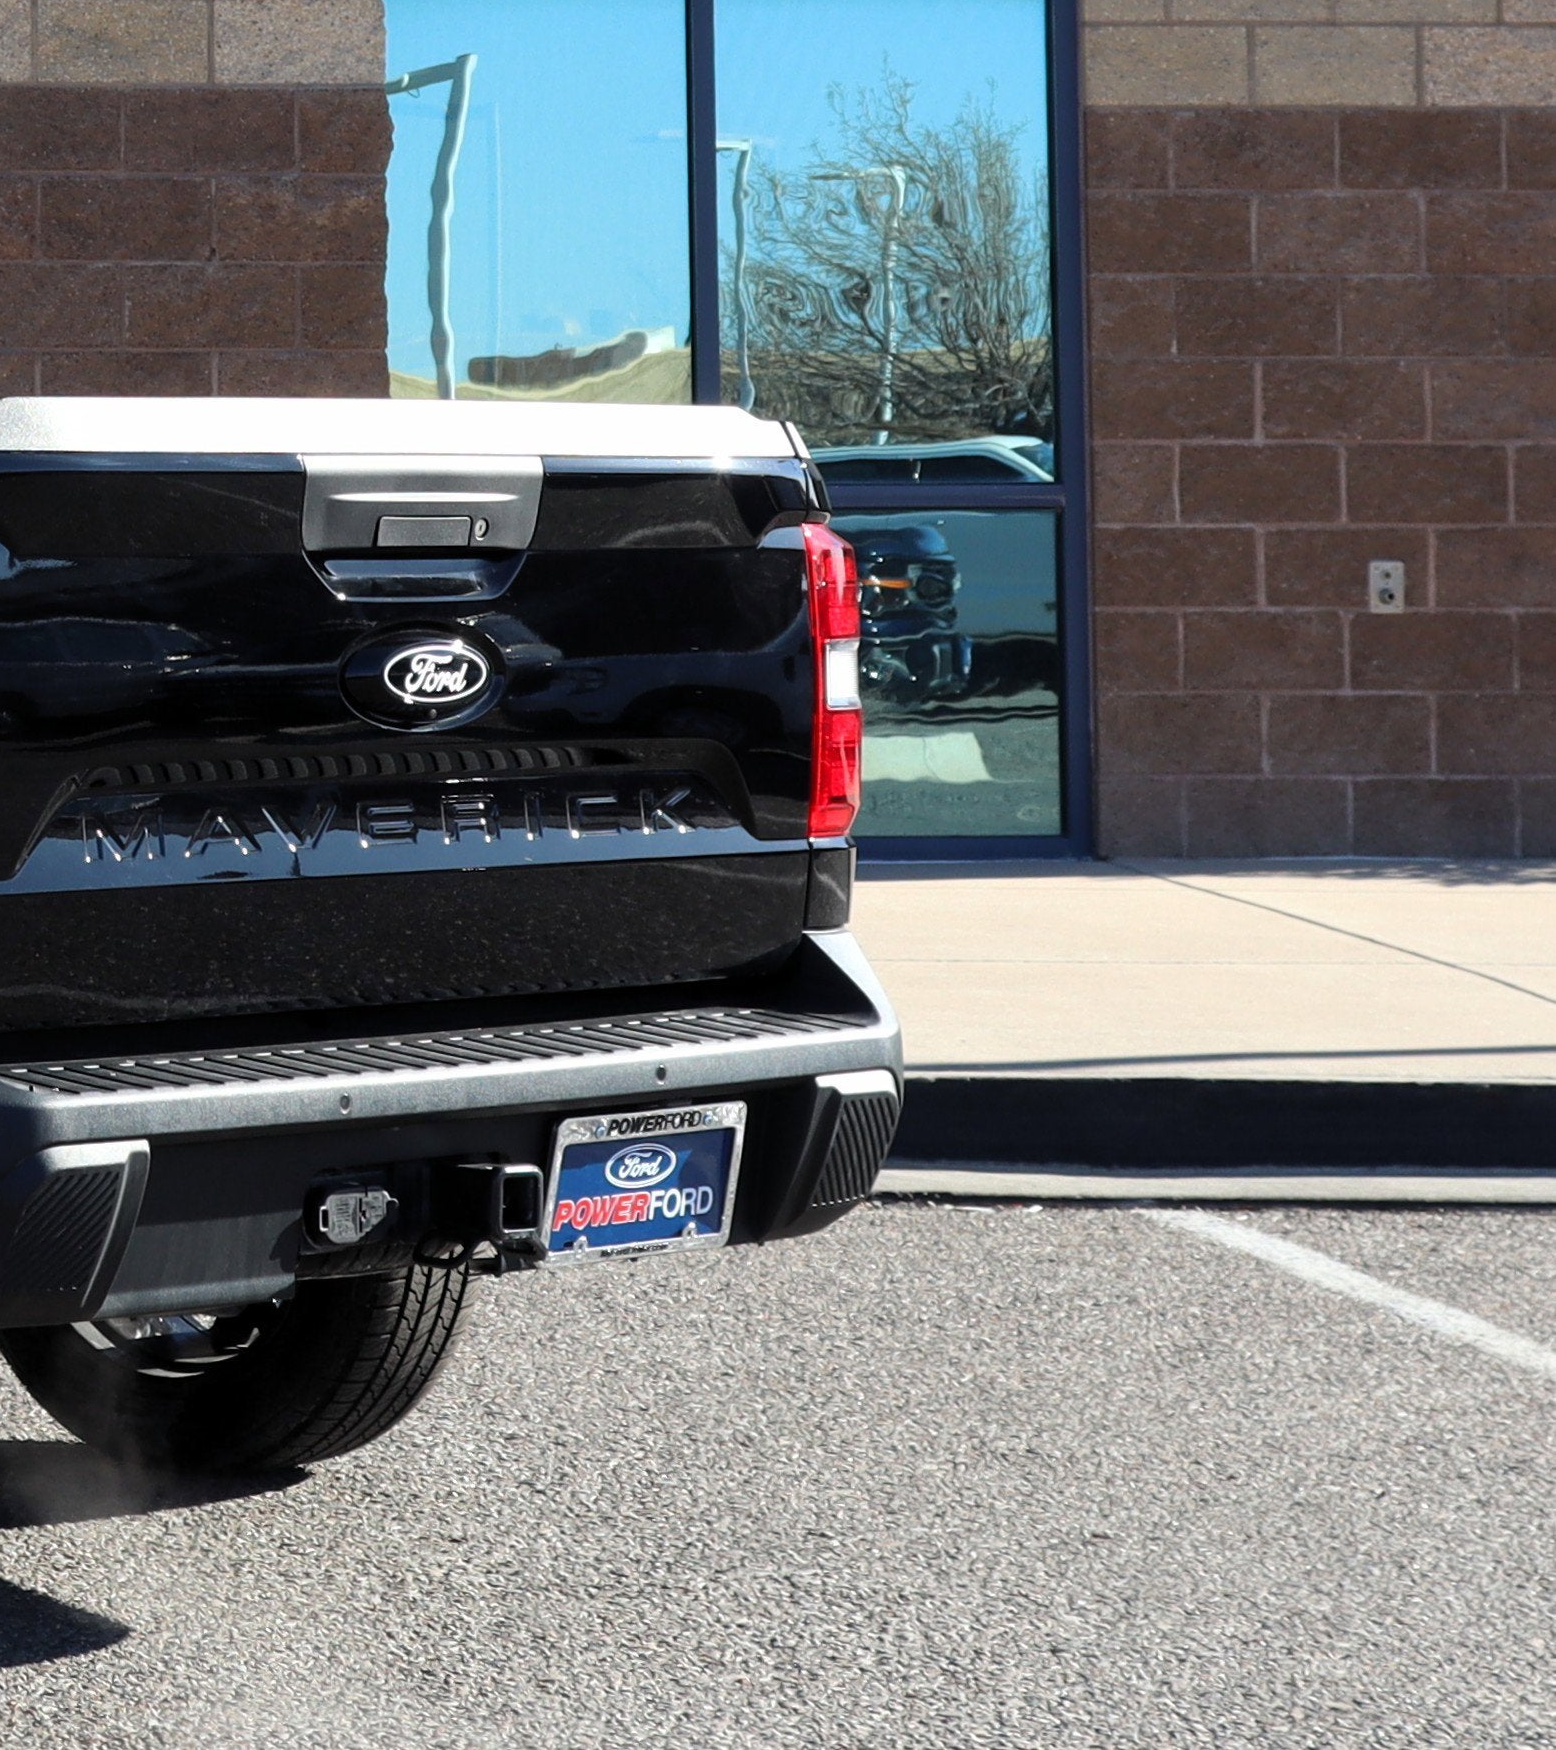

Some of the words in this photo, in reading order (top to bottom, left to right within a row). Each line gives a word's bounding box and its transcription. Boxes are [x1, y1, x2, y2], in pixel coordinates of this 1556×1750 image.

[404, 653, 469, 693] Ford
[81, 787, 691, 863] MAVERICK
[606, 1110, 702, 1136] POWERFORD
[618, 1151, 663, 1179] Ford
[552, 1186, 714, 1232] POWERFORD
